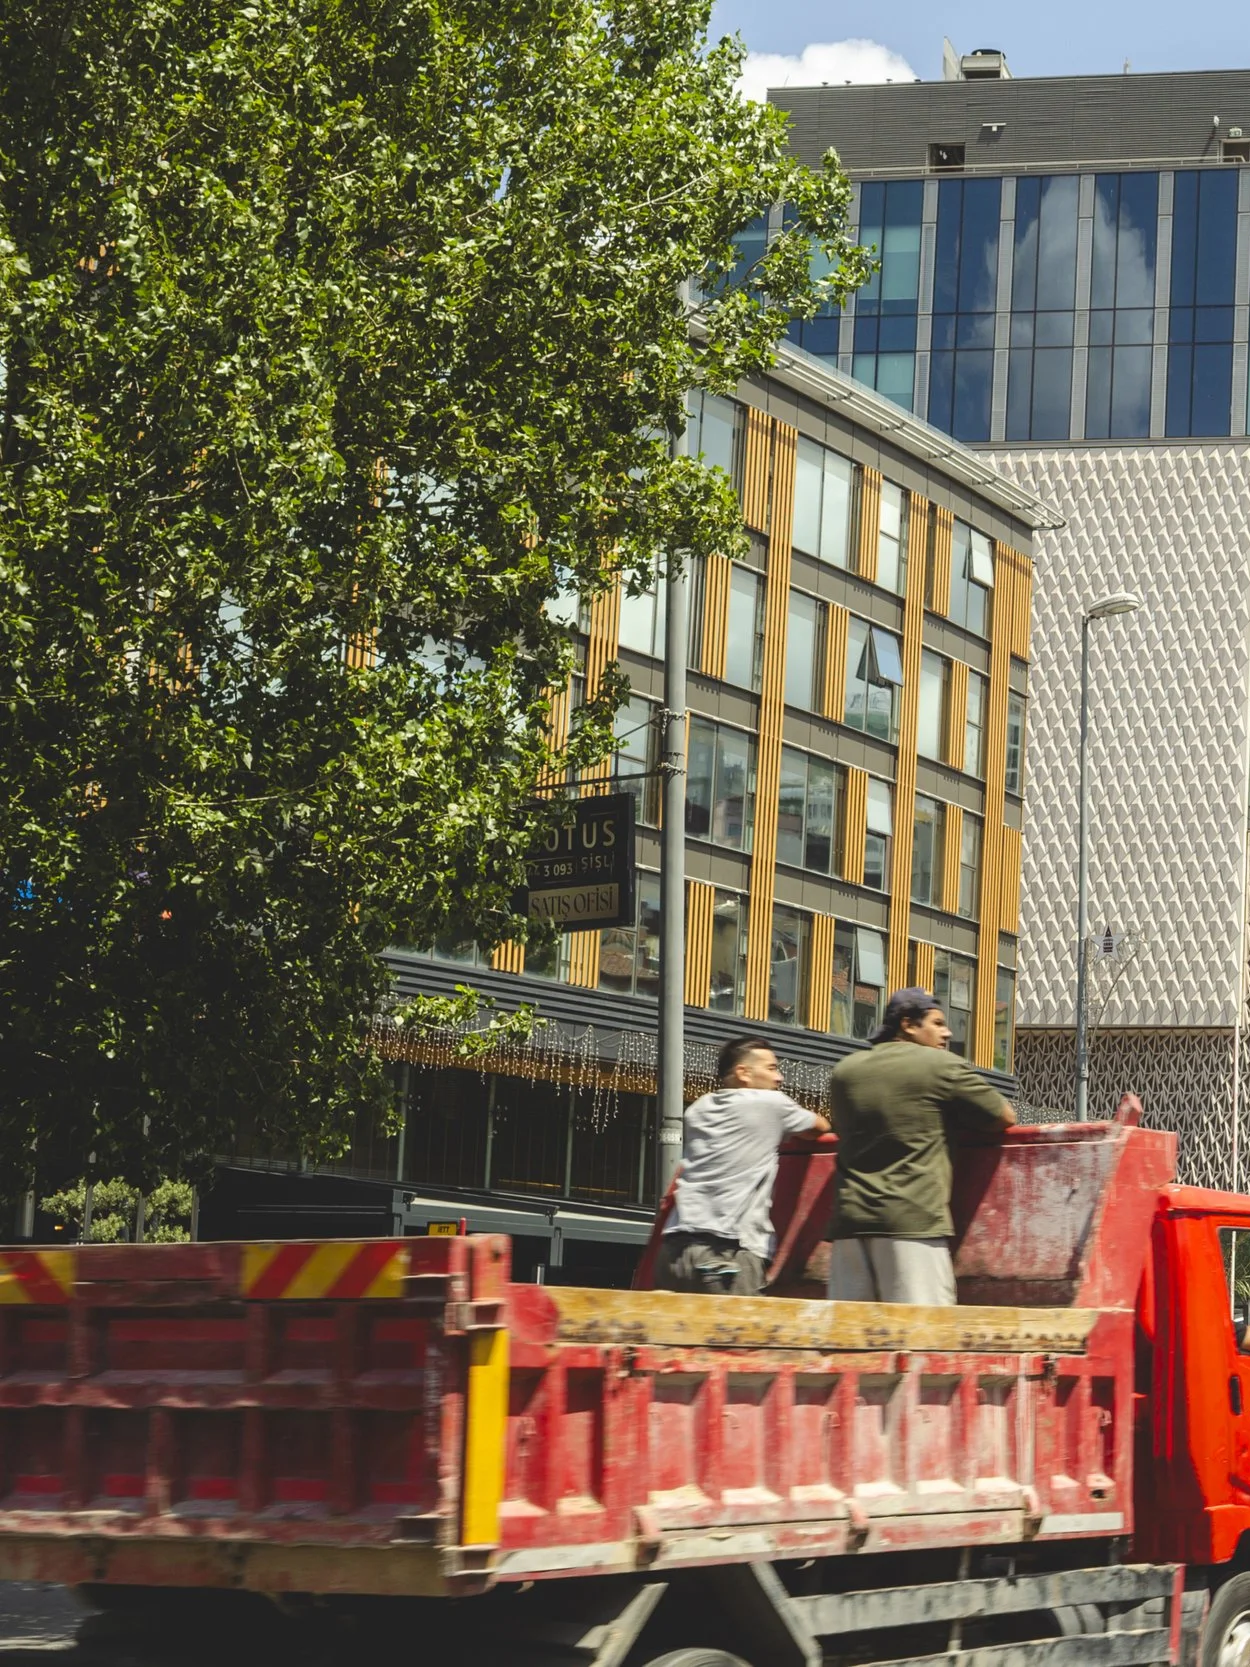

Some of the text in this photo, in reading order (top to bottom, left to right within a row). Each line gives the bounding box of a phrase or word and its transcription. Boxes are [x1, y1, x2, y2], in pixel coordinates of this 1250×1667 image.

[532, 819, 616, 853] OTUS
[543, 865, 550, 877] 3
[553, 862, 573, 876] 093
[530, 886, 614, 921] SATIŞ OFİSİ
